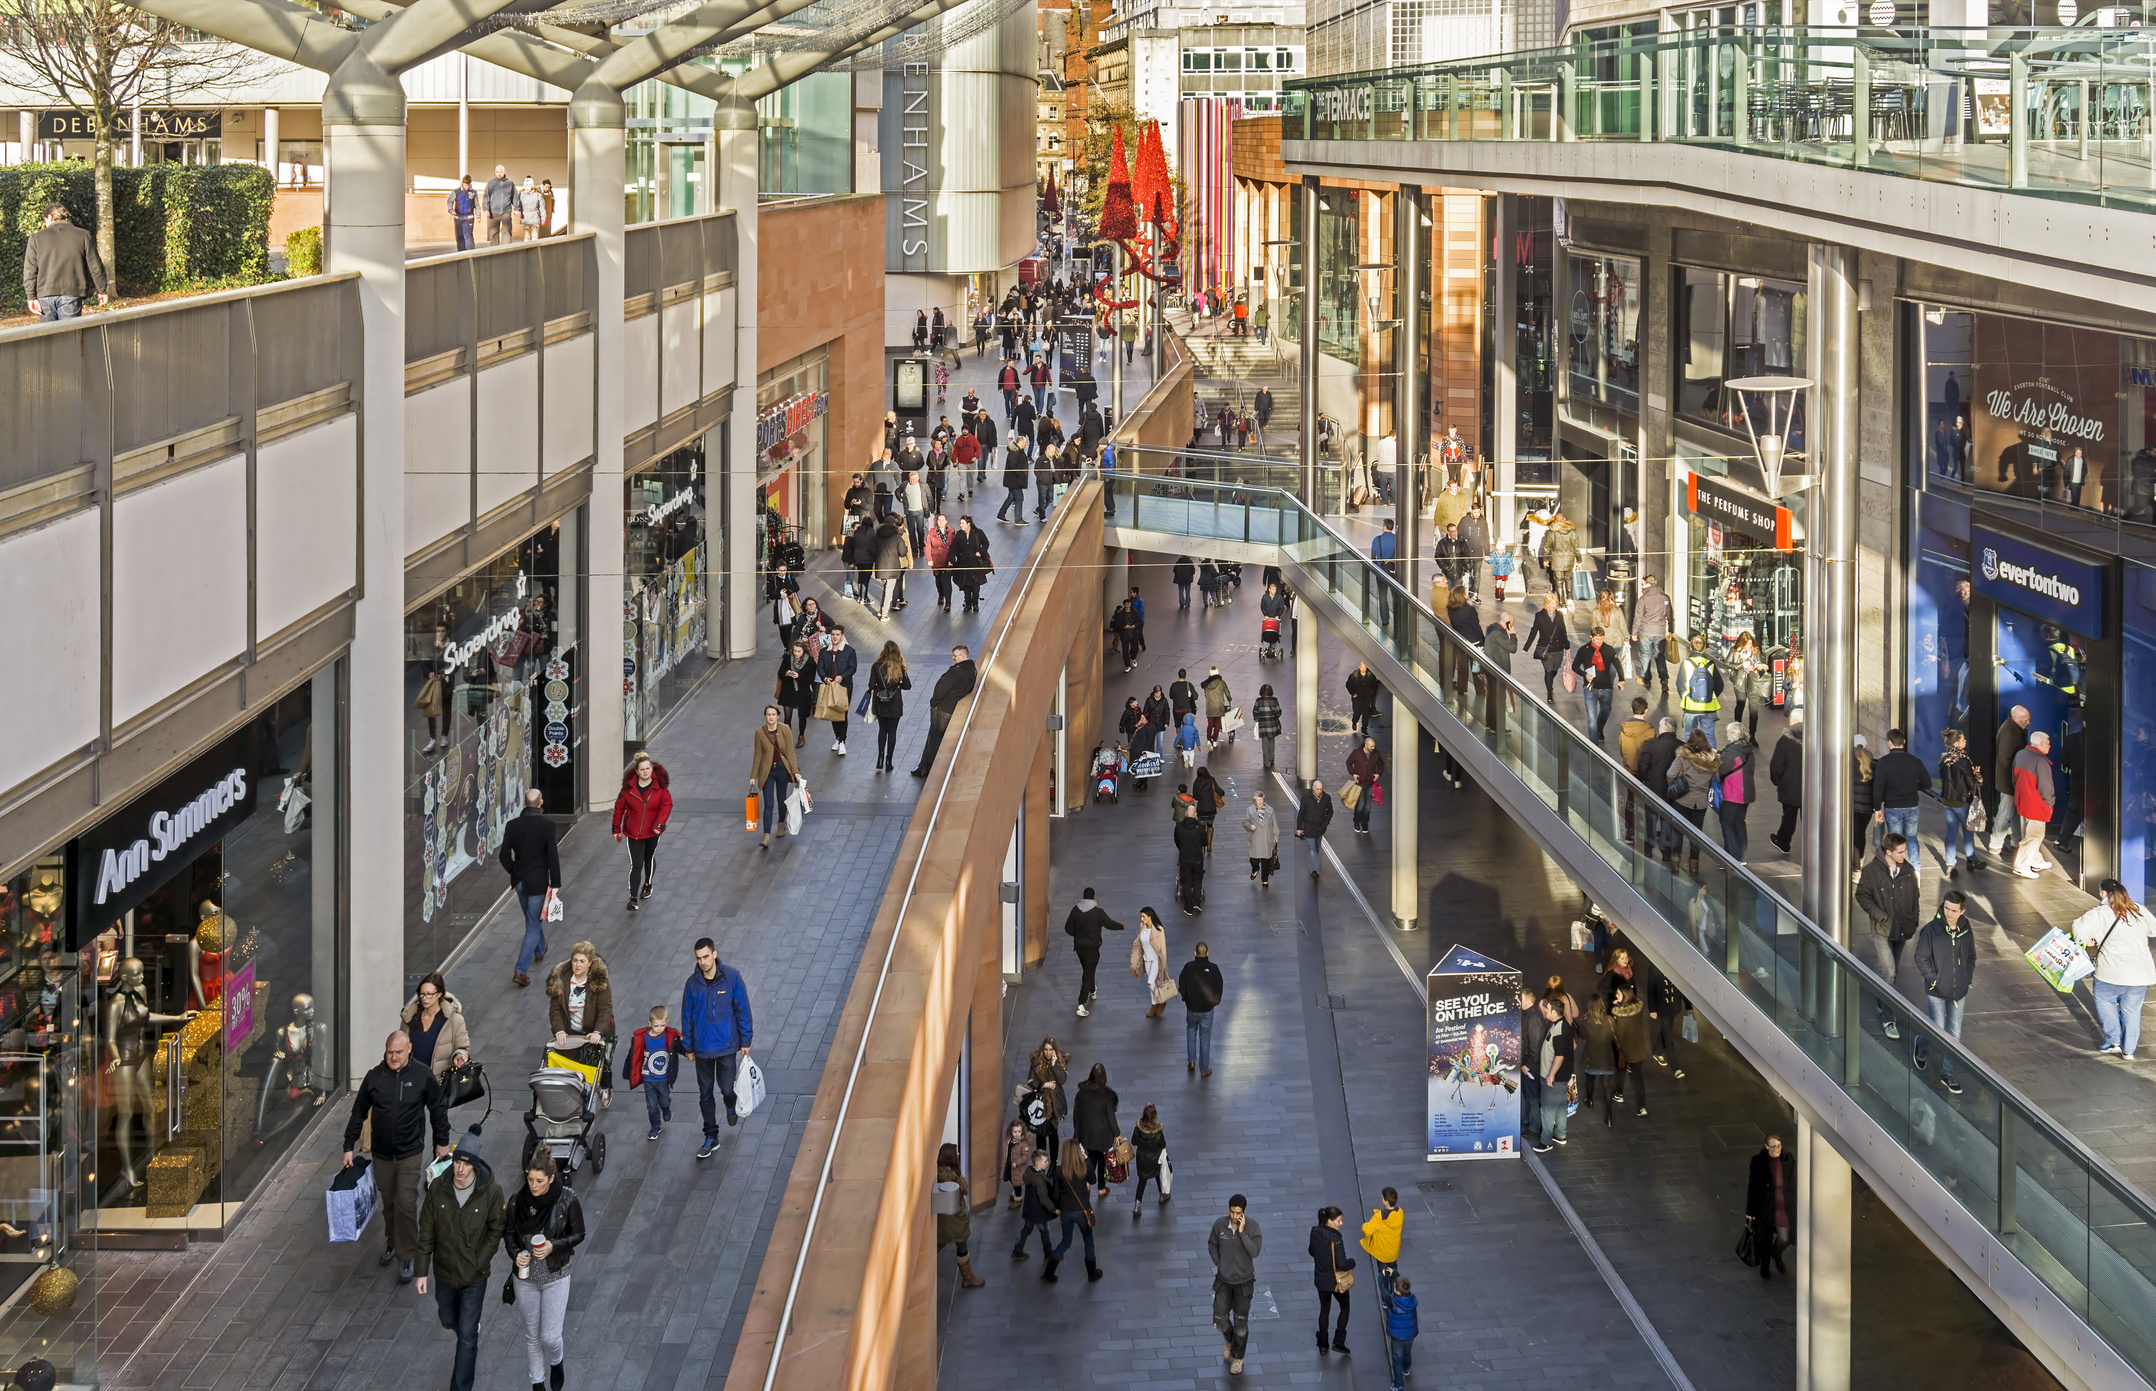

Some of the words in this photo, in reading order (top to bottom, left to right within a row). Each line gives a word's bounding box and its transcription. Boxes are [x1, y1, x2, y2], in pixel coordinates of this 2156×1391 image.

[53, 116, 207, 134] DEBNHAMS
[1325, 87, 1371, 122] TERRACE
[902, 33, 929, 257] BENHAMS
[2013, 381, 2035, 391] EVERTON
[2036, 382, 2060, 394] FOOTBALL
[2060, 390, 2074, 403] CLUB
[756, 391, 829, 456] PORTSDIRECT.COM
[1987, 389, 2011, 419] We
[2013, 397, 2047, 428] Are
[2048, 402, 2105, 442] Chosen
[647, 486, 693, 527] Superdrug
[1697, 489, 1711, 505] THE
[1714, 496, 1749, 521] PERFUME
[1752, 512, 1776, 532] SHOP
[1999, 561, 2079, 606] evertontwo
[443, 606, 521, 675] Superdrug
[94, 839, 149, 905] Ann
[149, 768, 247, 862] Summers
[231, 983, 251, 1020] 30%
[1435, 997, 1461, 1012] SEE
[1461, 993, 1490, 1007] YOU
[1435, 1009, 1455, 1023] ON
[1456, 1005, 1482, 1020] THE
[1483, 1002, 1508, 1016] ICE.
[1444, 1023, 1467, 1033] Festival
